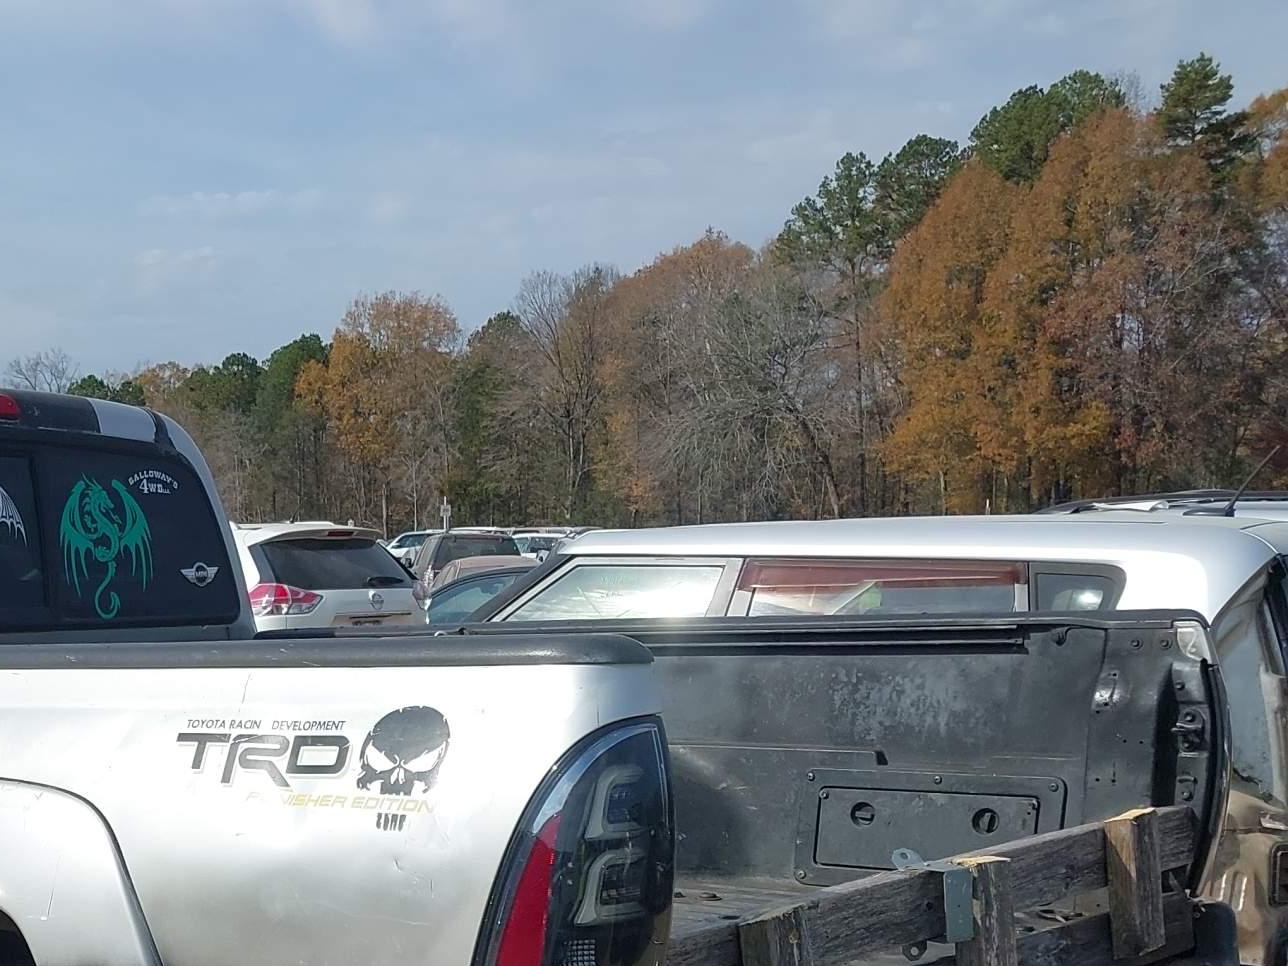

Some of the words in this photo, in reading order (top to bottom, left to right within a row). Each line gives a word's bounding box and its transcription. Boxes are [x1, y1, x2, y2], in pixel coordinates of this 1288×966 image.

[186, 719, 226, 729] TOYOTA
[271, 720, 346, 731] DEVELOPMENT
[176, 732, 352, 789] TRD
[350, 796, 434, 813] EDITION
